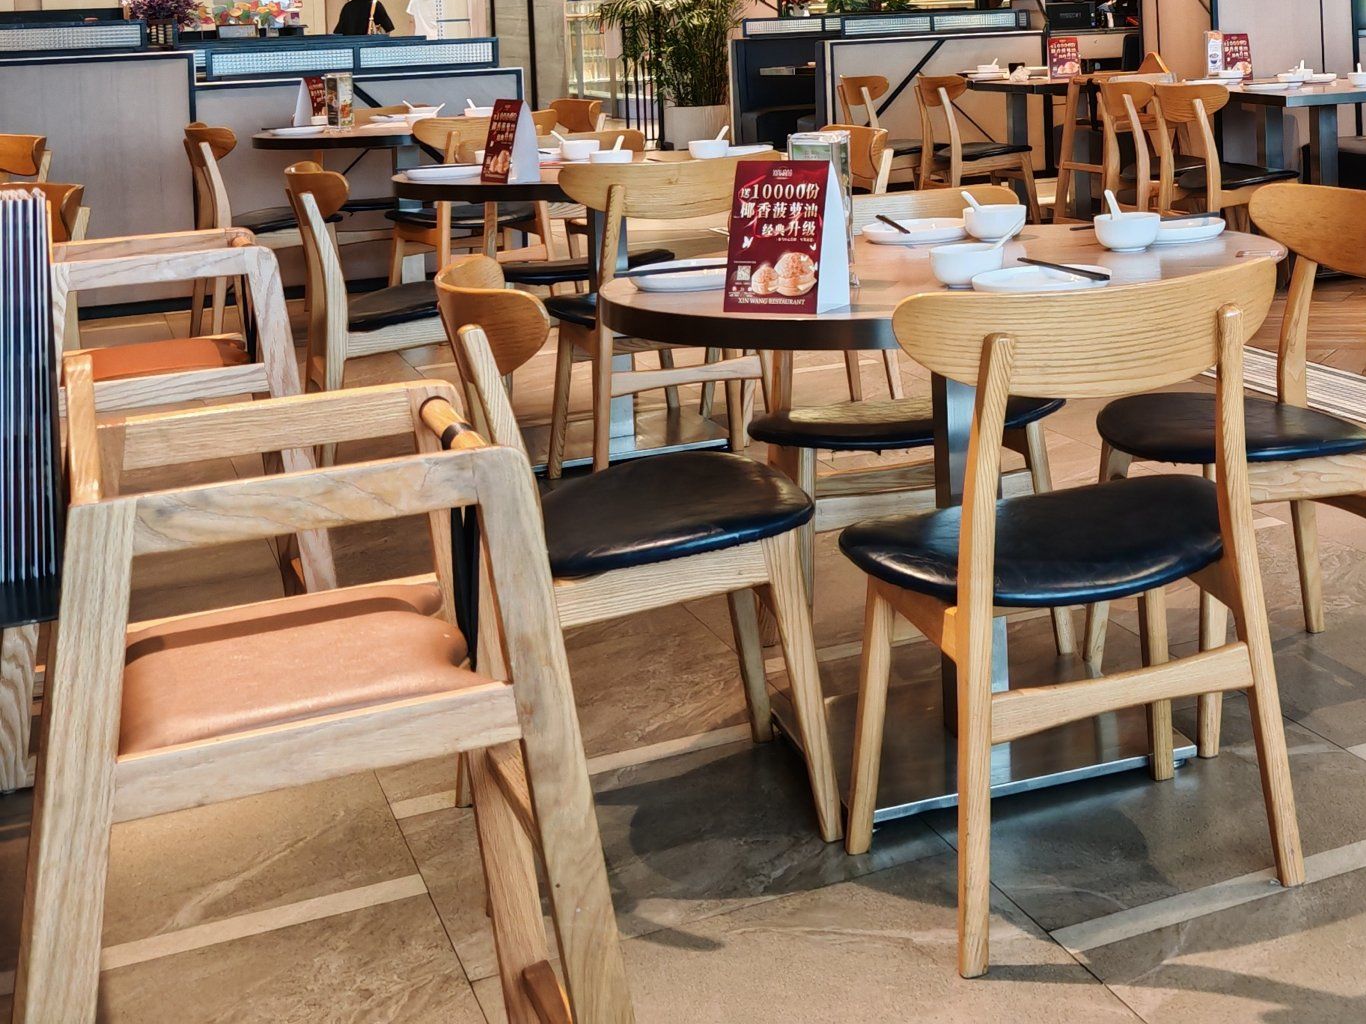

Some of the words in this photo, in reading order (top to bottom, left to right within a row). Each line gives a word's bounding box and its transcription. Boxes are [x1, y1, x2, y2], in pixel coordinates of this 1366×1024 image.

[740, 202, 818, 219] 椰香菠萝油
[762, 221, 816, 237] 经典升级
